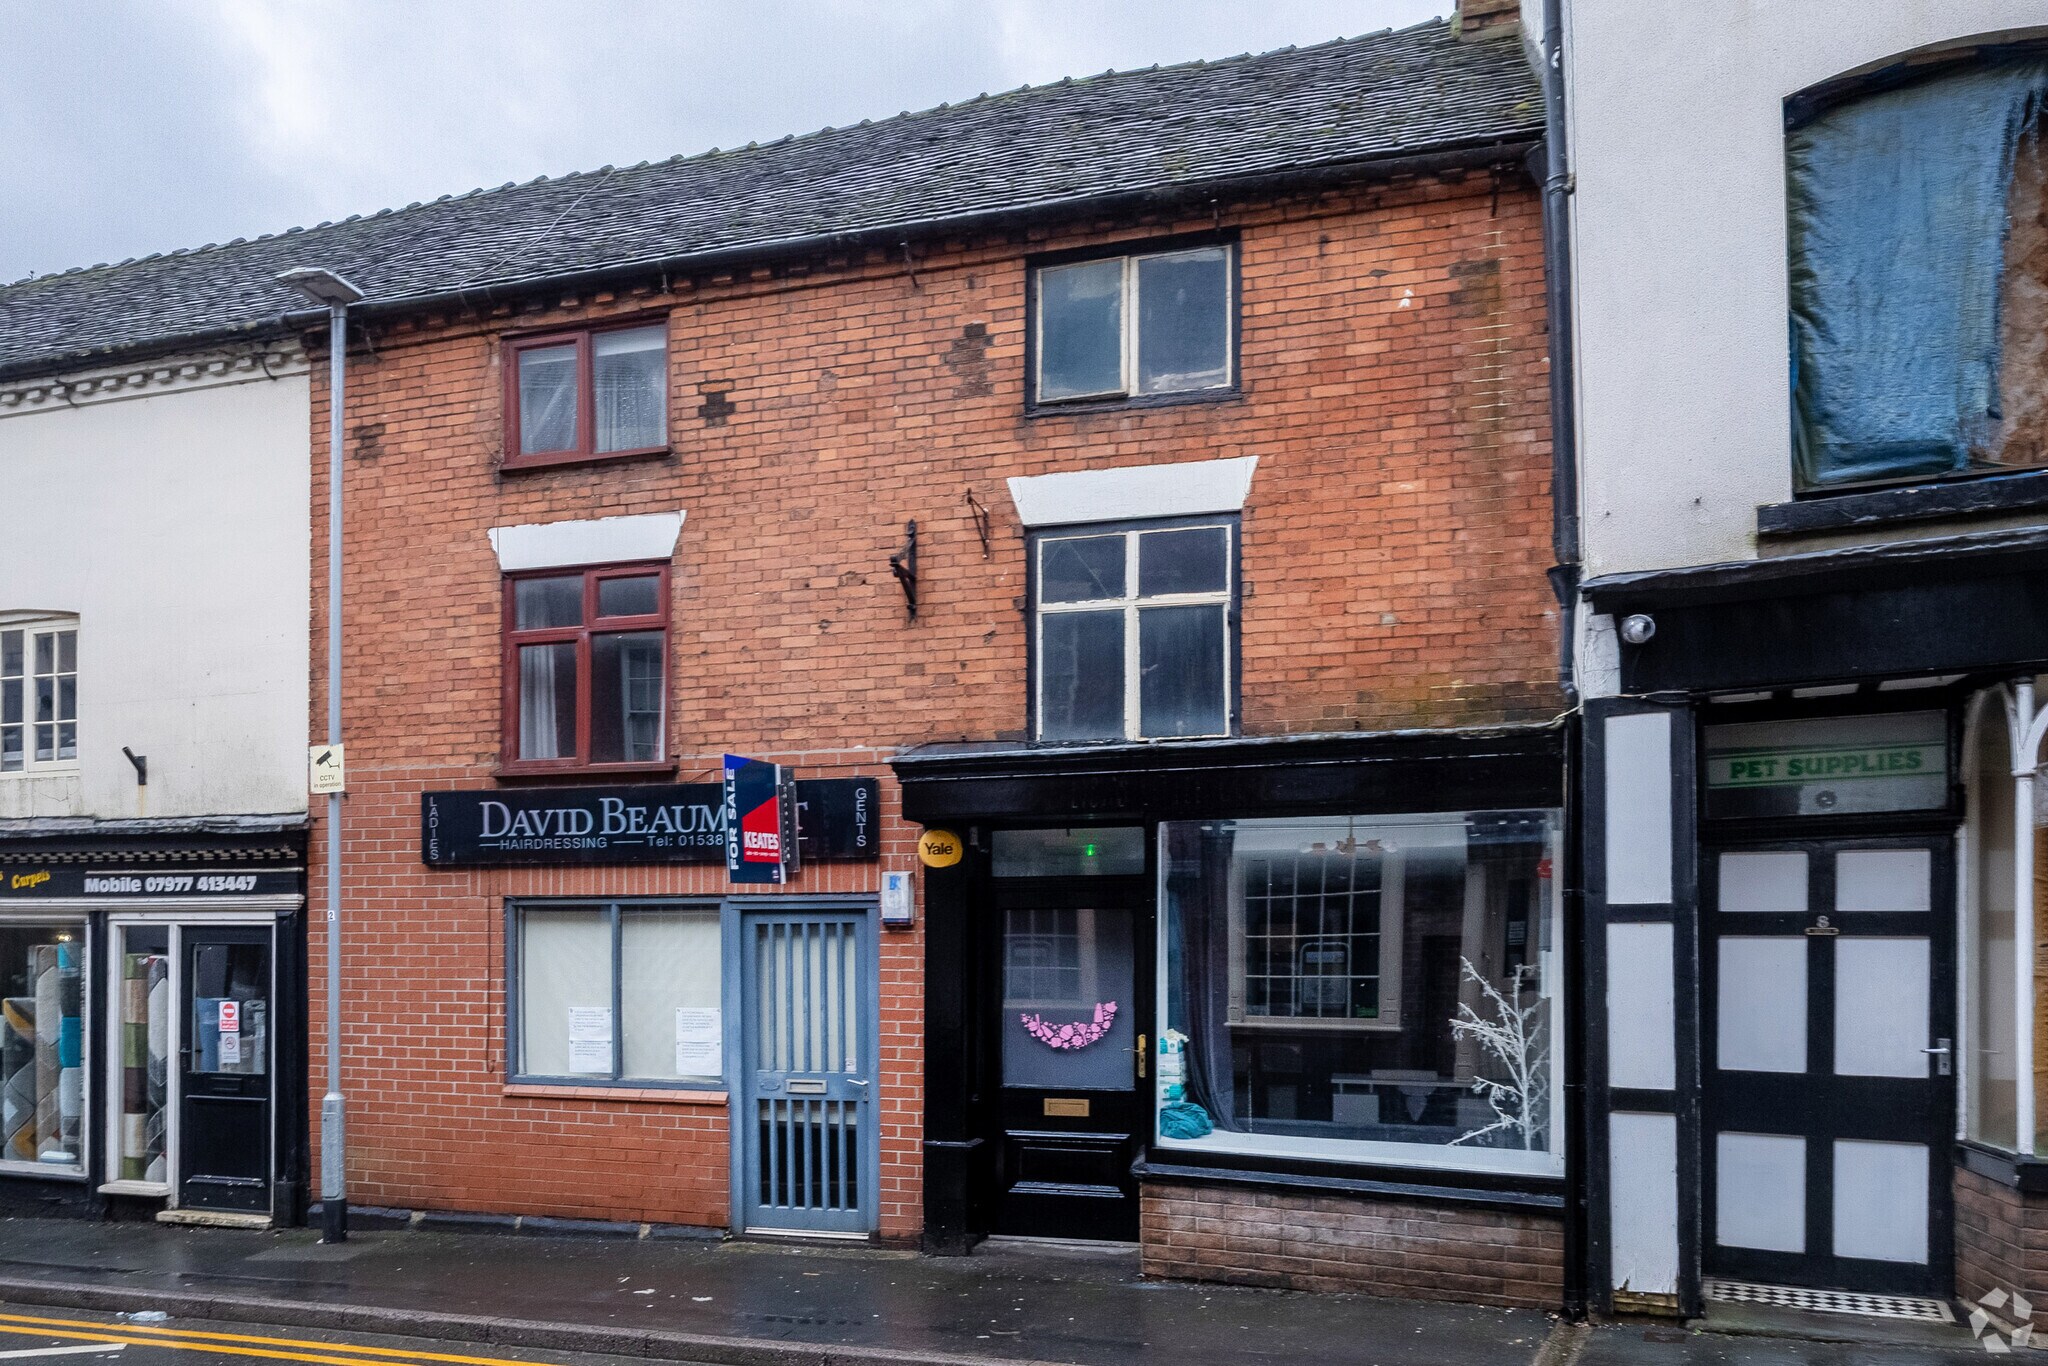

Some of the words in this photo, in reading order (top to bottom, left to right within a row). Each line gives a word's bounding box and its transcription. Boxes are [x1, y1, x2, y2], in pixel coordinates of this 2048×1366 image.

[1729, 759, 1779, 779] PET
[1787, 751, 1922, 776] SUPPLIES
[725, 768, 737, 820] SALE
[428, 796, 439, 860] LADIES
[478, 801, 594, 837] DAVID
[598, 797, 808, 835] BEAUM
[855, 787, 868, 847] GENTS
[500, 837, 608, 850] HAIRDRESSING
[647, 835, 674, 847] Tel:
[678, 834, 724, 846] 01538
[728, 827, 739, 870] FOR
[743, 831, 779, 850] KEATES
[924, 842, 954, 856] Yale
[11, 869, 51, 890] Carpets
[84, 877, 142, 893] Mobile
[145, 876, 195, 892] 07977
[196, 875, 257, 892] 413447
[1815, 915, 1830, 928] 8
